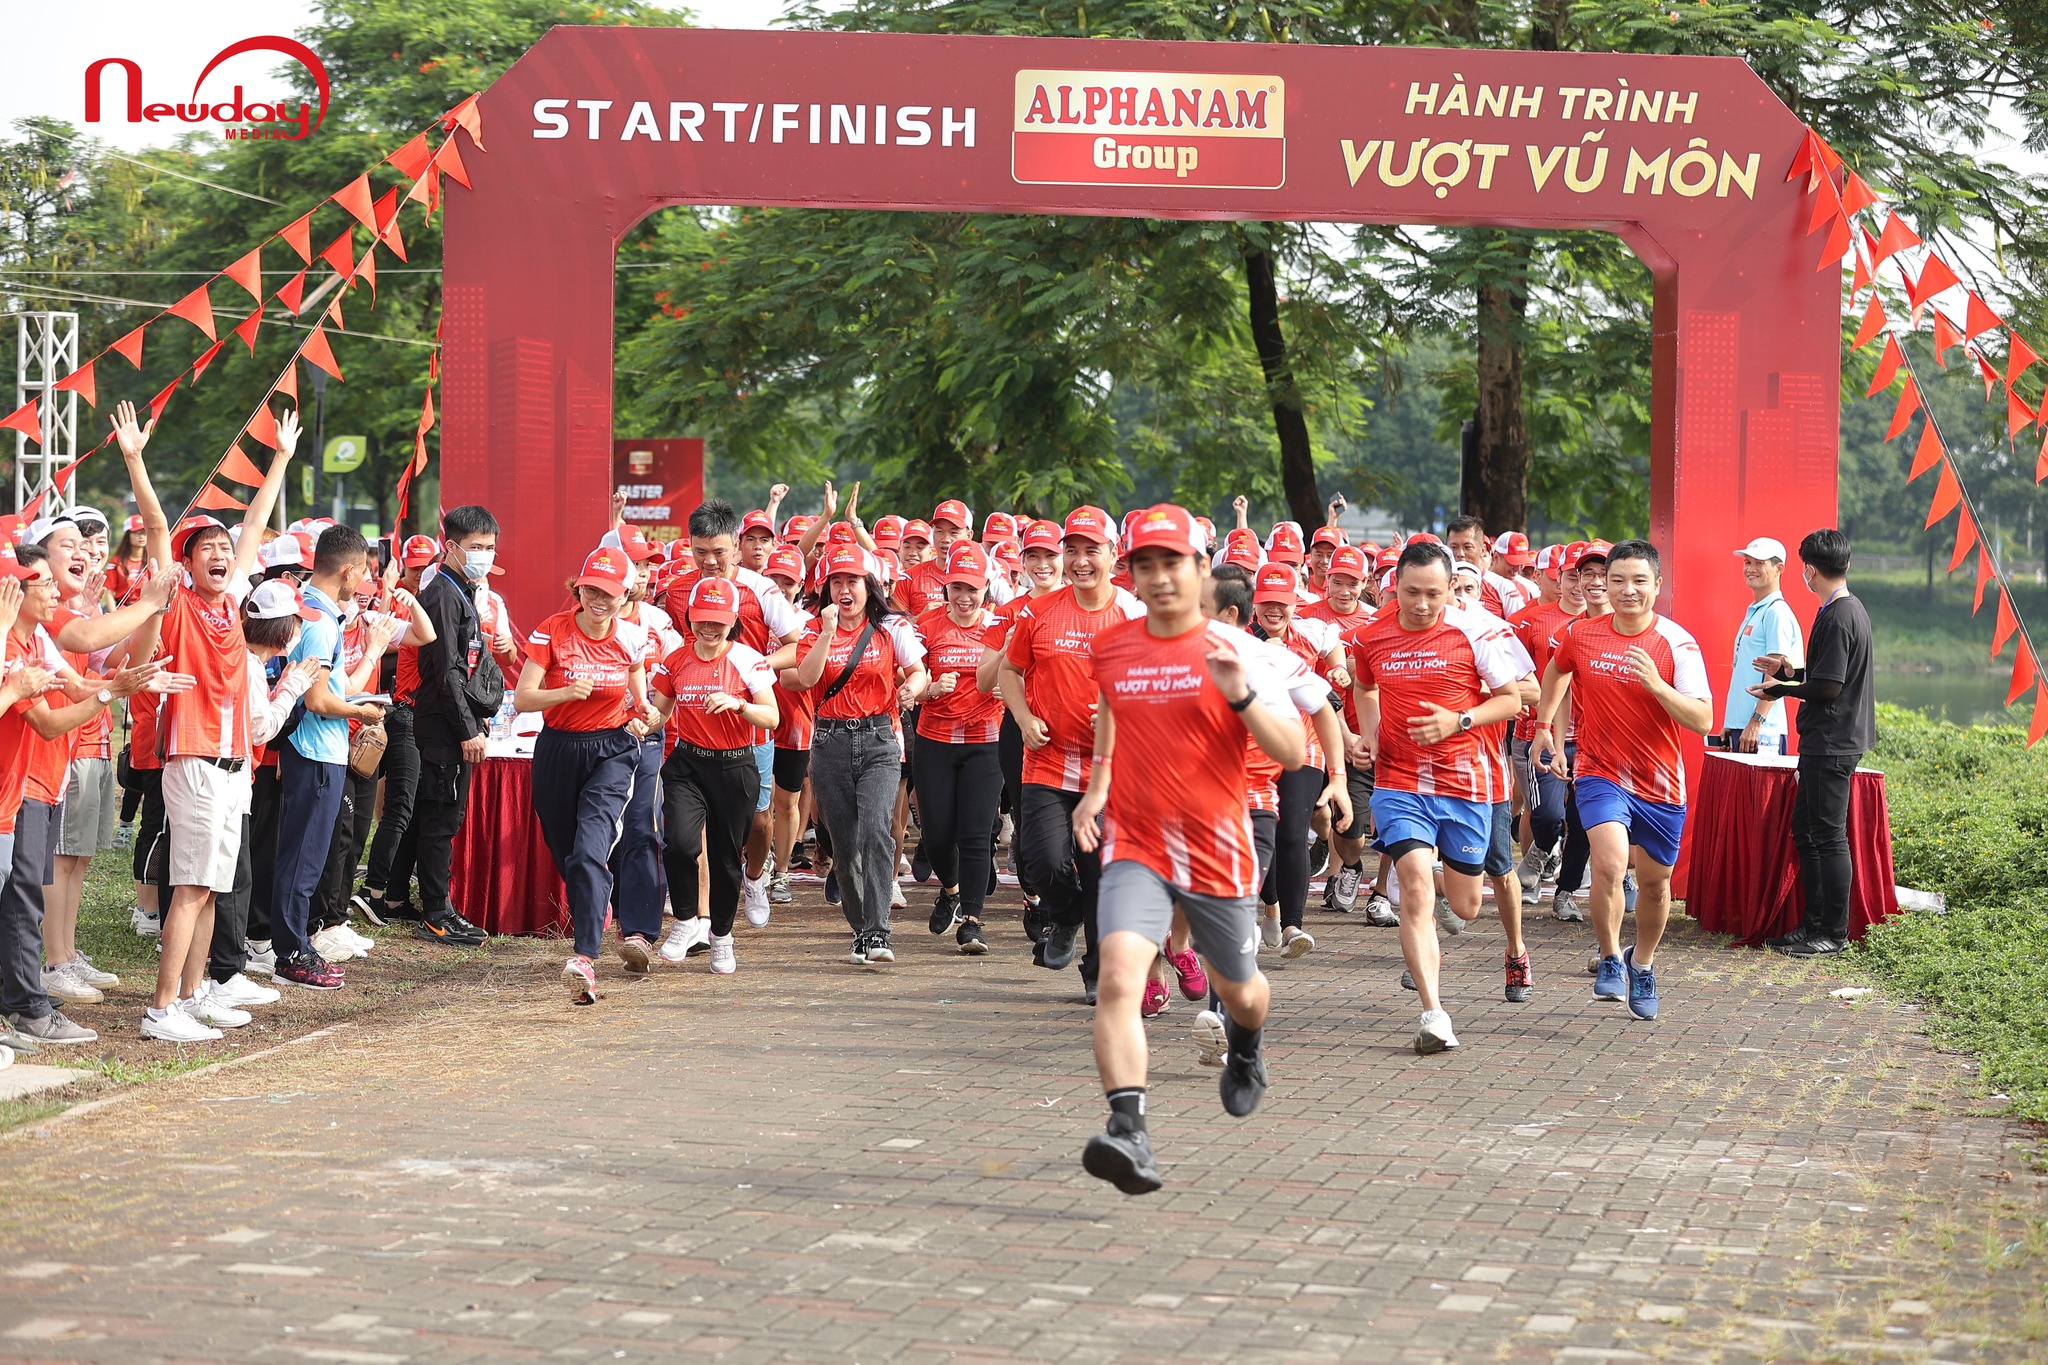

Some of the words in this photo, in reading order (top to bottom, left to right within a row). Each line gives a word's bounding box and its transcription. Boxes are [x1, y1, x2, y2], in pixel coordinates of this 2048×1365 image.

[531, 98, 977, 149] START/FINISH
[1404, 73, 1544, 119] HÀNH
[1558, 78, 1699, 124] TRÌNH
[1092, 136, 1199, 178] Group
[1339, 137, 1511, 199] VƯỢT
[1525, 128, 1609, 194] VŨ
[1622, 136, 1762, 201] MÔN
[692, 746, 715, 757] FENDI
[722, 748, 745, 758] FENDI
